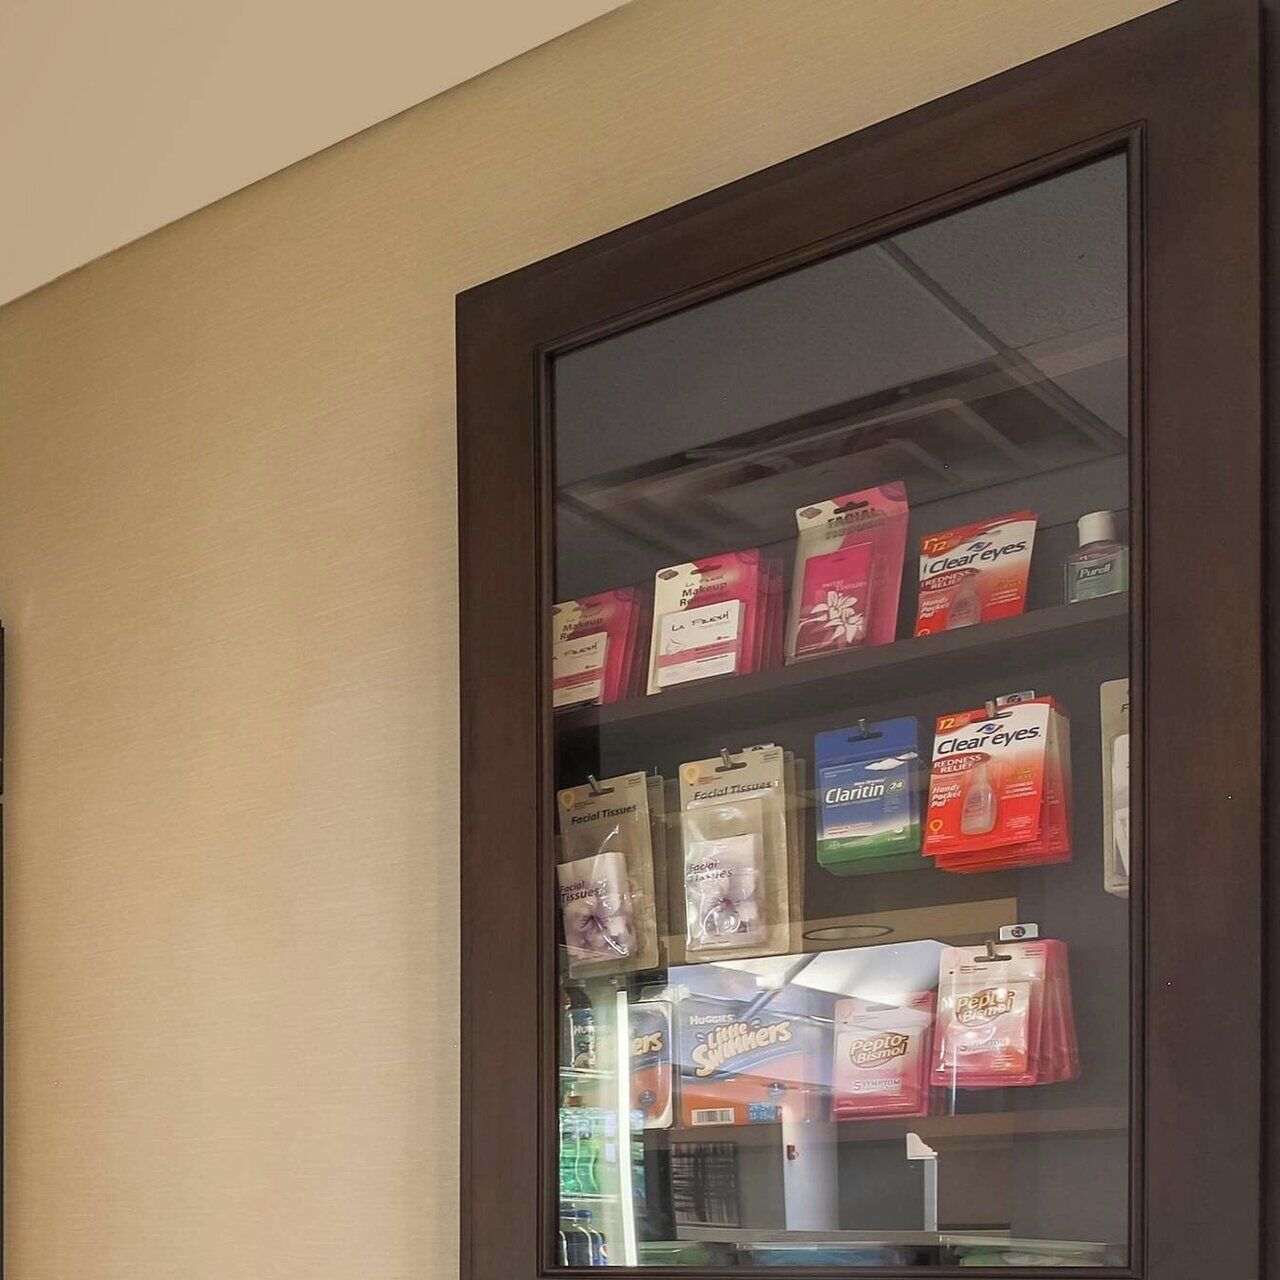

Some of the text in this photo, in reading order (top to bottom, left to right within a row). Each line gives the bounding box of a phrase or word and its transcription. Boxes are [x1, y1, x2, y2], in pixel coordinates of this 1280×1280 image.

[928, 540, 1027, 574] Clear eyes
[1078, 561, 1112, 579] Purell
[681, 581, 728, 598] Makeup
[562, 616, 604, 632] Makeup
[938, 717, 955, 731] 12
[936, 733, 992, 756] Clear
[933, 754, 983, 769] REDNESS
[940, 762, 974, 774] RELIEF
[693, 780, 773, 801] Facial Tissues
[824, 782, 885, 806] Claritin
[931, 790, 962, 801] Pocket
[932, 783, 962, 795] Handy
[931, 798, 951, 808] Pal
[571, 804, 638, 825] Facial Tissues
[560, 880, 586, 893] Facial
[560, 887, 601, 904] Tissues
[962, 996, 1014, 1023] Bismol
[690, 1014, 735, 1026] HUGGIES
[707, 1021, 749, 1047] Little
[692, 1020, 793, 1078] Swimmers
[849, 1032, 910, 1056] Pepto-
[856, 1040, 909, 1063] Bismol
[862, 1077, 902, 1088] SYMPTOM
